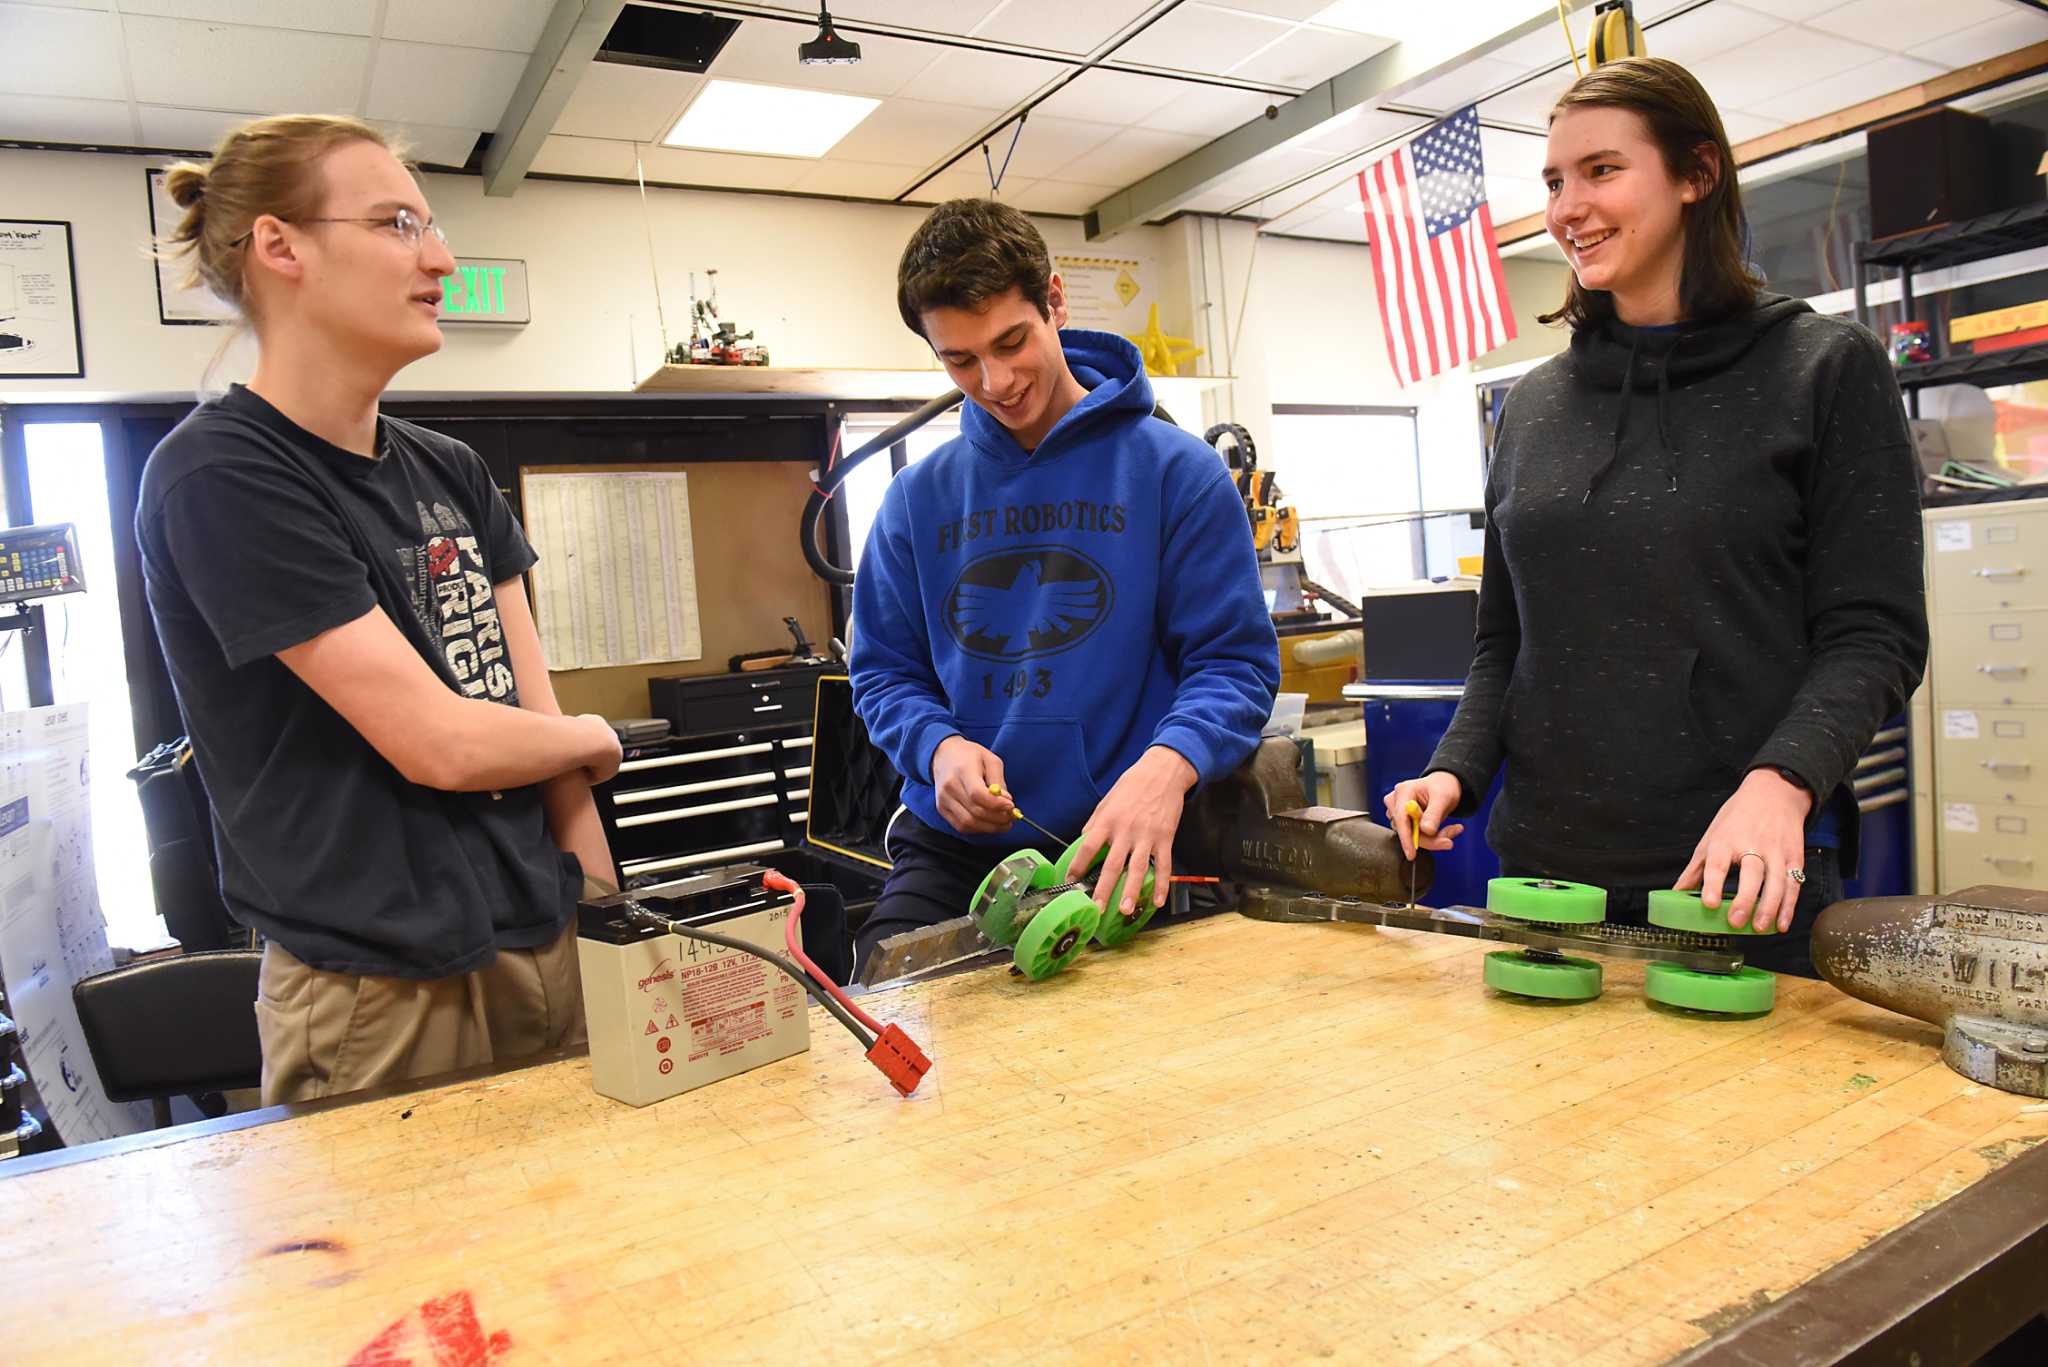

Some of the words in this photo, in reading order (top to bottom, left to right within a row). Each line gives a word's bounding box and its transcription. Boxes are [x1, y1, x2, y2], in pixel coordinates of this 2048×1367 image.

[442, 265, 507, 314] EXIT
[1004, 500, 1126, 536] ROBOTICS
[455, 535, 514, 698] PARIS
[982, 668, 1053, 700] 1493
[1241, 839, 1314, 868] WILTON
[1956, 911, 1989, 926] MADE
[2016, 919, 2044, 932] USA
[1949, 951, 2048, 994] WIL
[2017, 996, 2048, 1010] PAR
